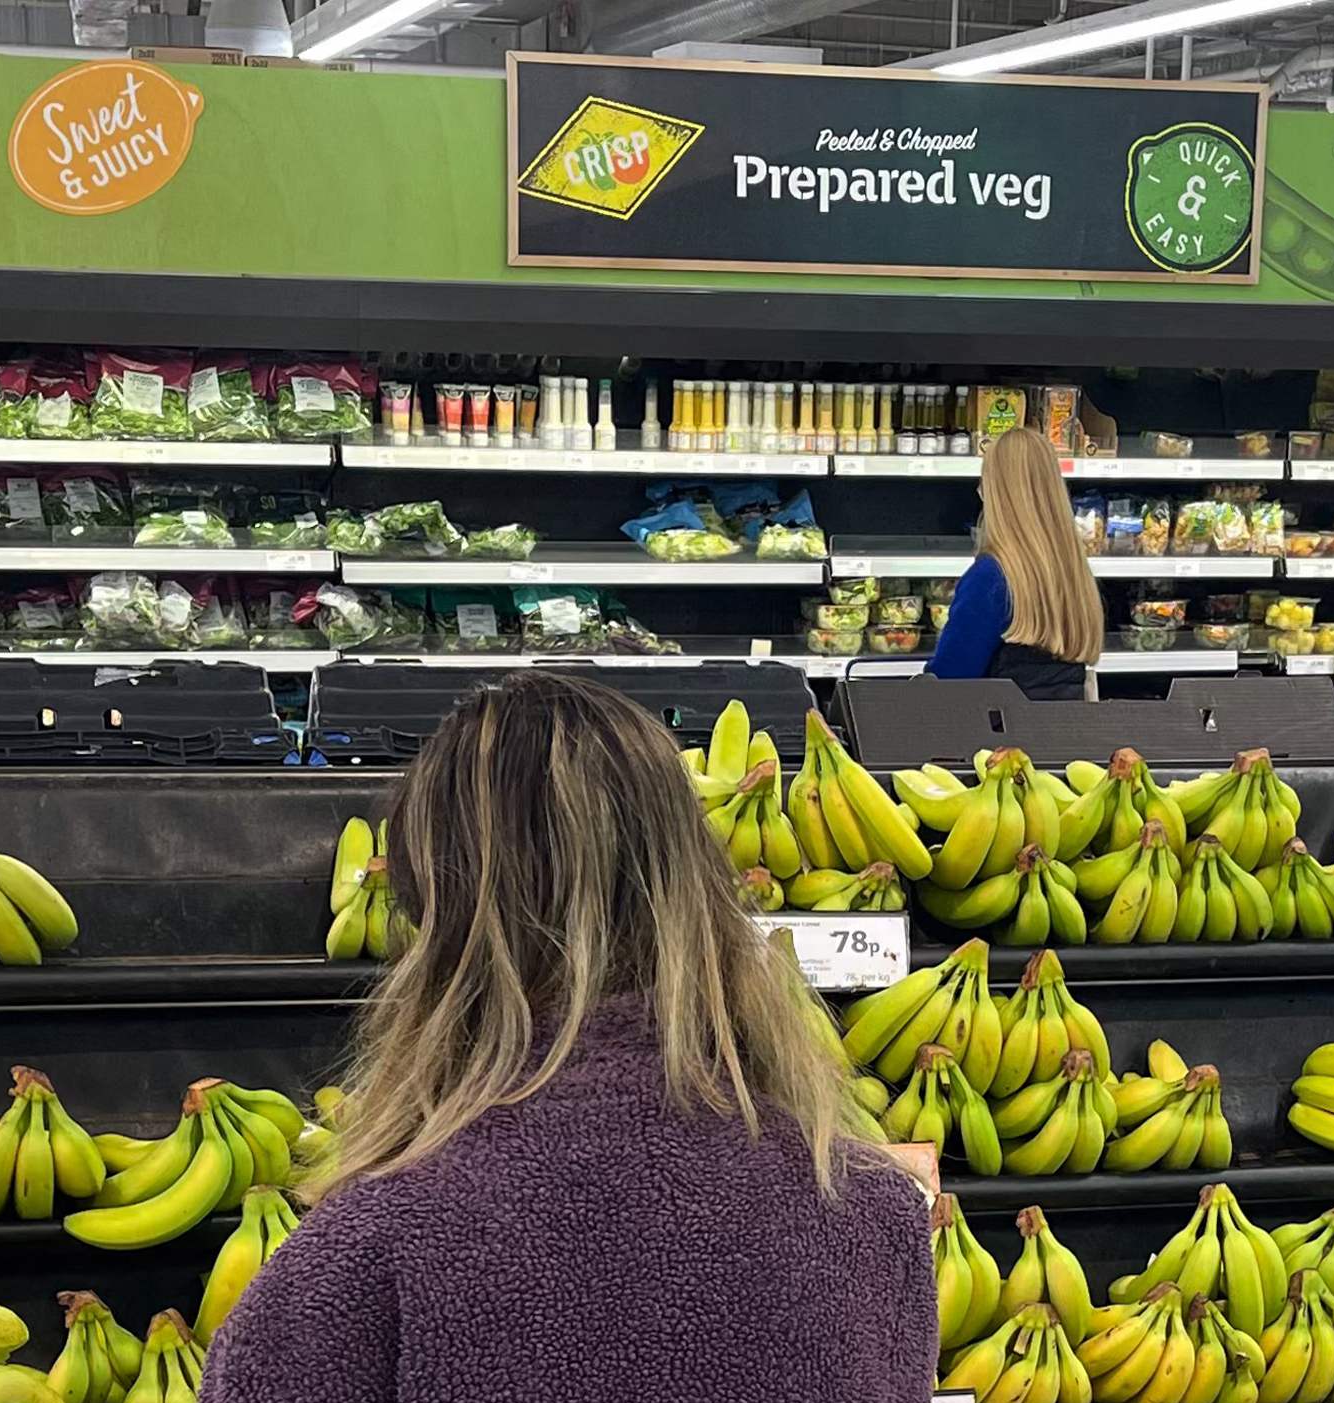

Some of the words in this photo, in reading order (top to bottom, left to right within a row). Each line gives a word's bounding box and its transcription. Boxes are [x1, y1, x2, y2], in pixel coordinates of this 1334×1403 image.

[43, 72, 146, 164] Sweet
[816, 129, 879, 151] Peeled
[880, 131, 895, 149] &
[897, 127, 978, 156] Chopped
[59, 168, 89, 199] &
[87, 122, 169, 187] JUICY
[565, 130, 649, 186] CRISP
[1179, 141, 1242, 188] QUICK
[733, 155, 957, 213] Prepared
[968, 172, 1052, 220] veg
[1178, 175, 1207, 221] &
[1145, 212, 1204, 256] EASY
[830, 931, 880, 957] 78p
